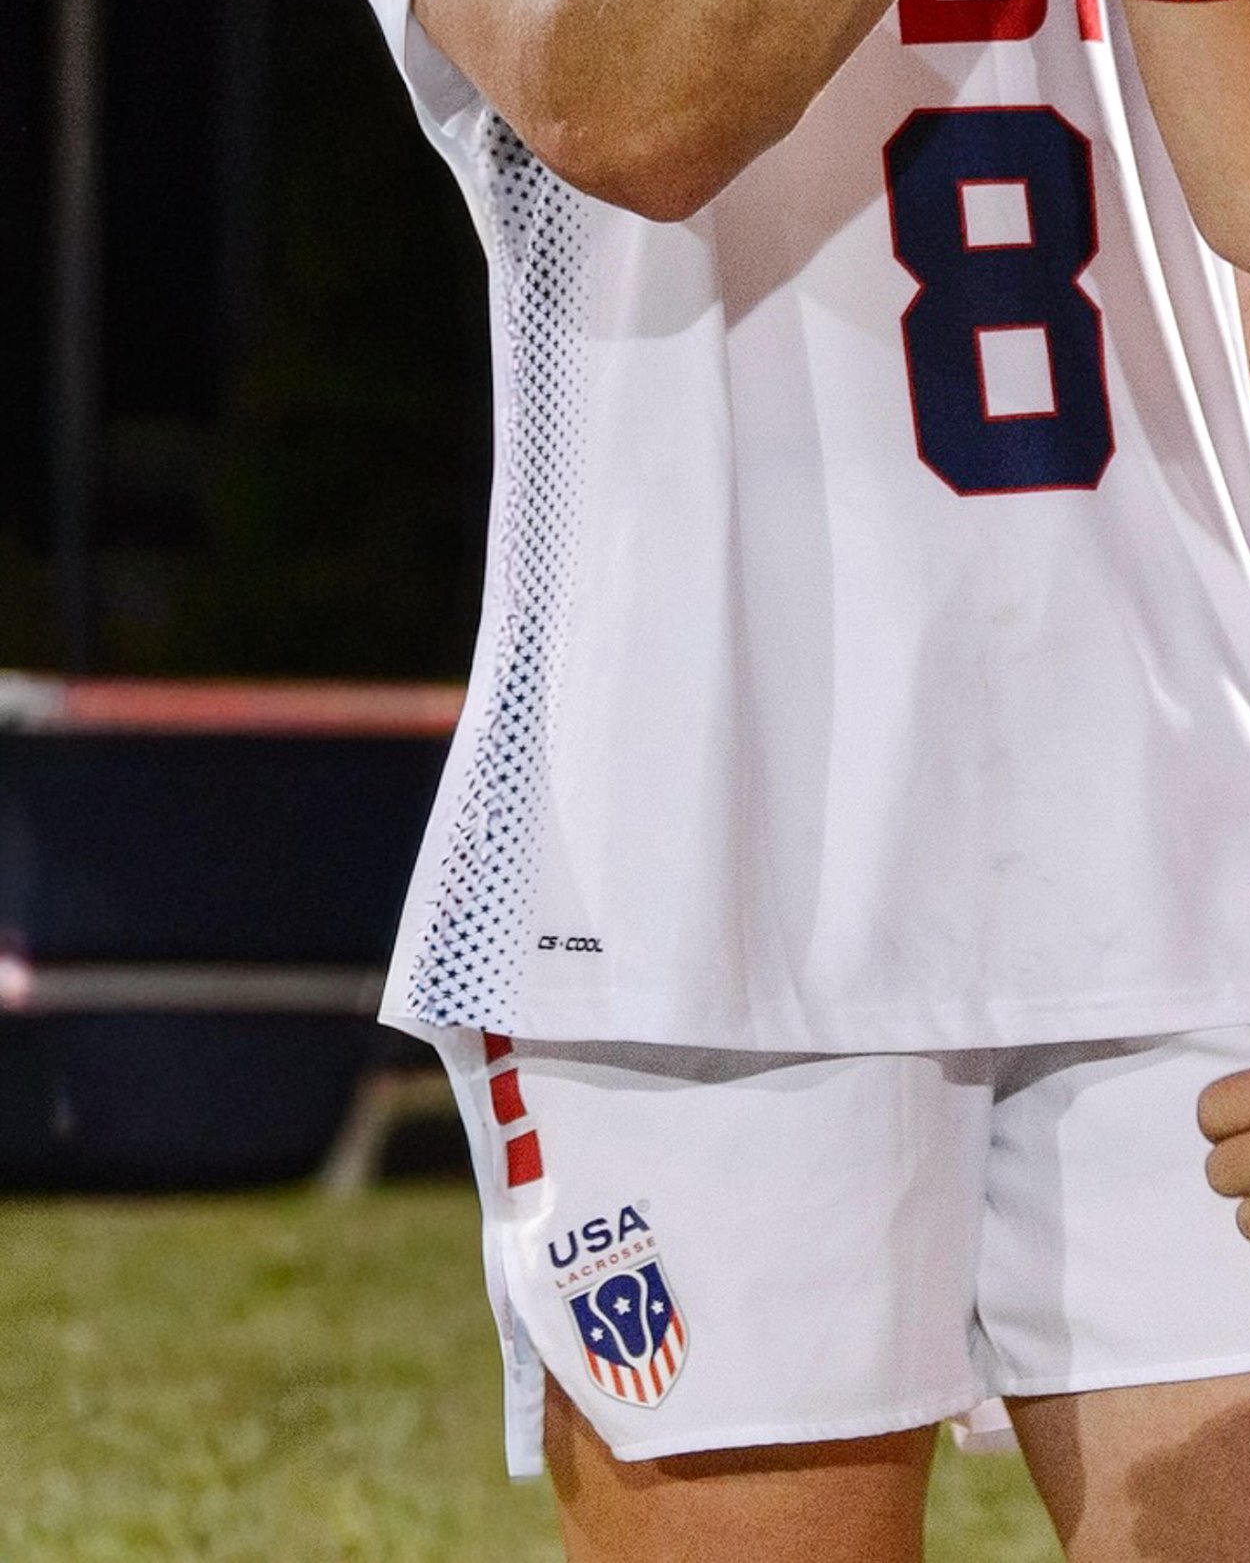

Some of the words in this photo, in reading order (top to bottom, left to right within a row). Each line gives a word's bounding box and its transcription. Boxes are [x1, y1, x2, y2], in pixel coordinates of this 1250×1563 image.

[882, 105, 1116, 497] 8
[548, 1205, 650, 1269] USA
[556, 1238, 656, 1289] LACROSSE
